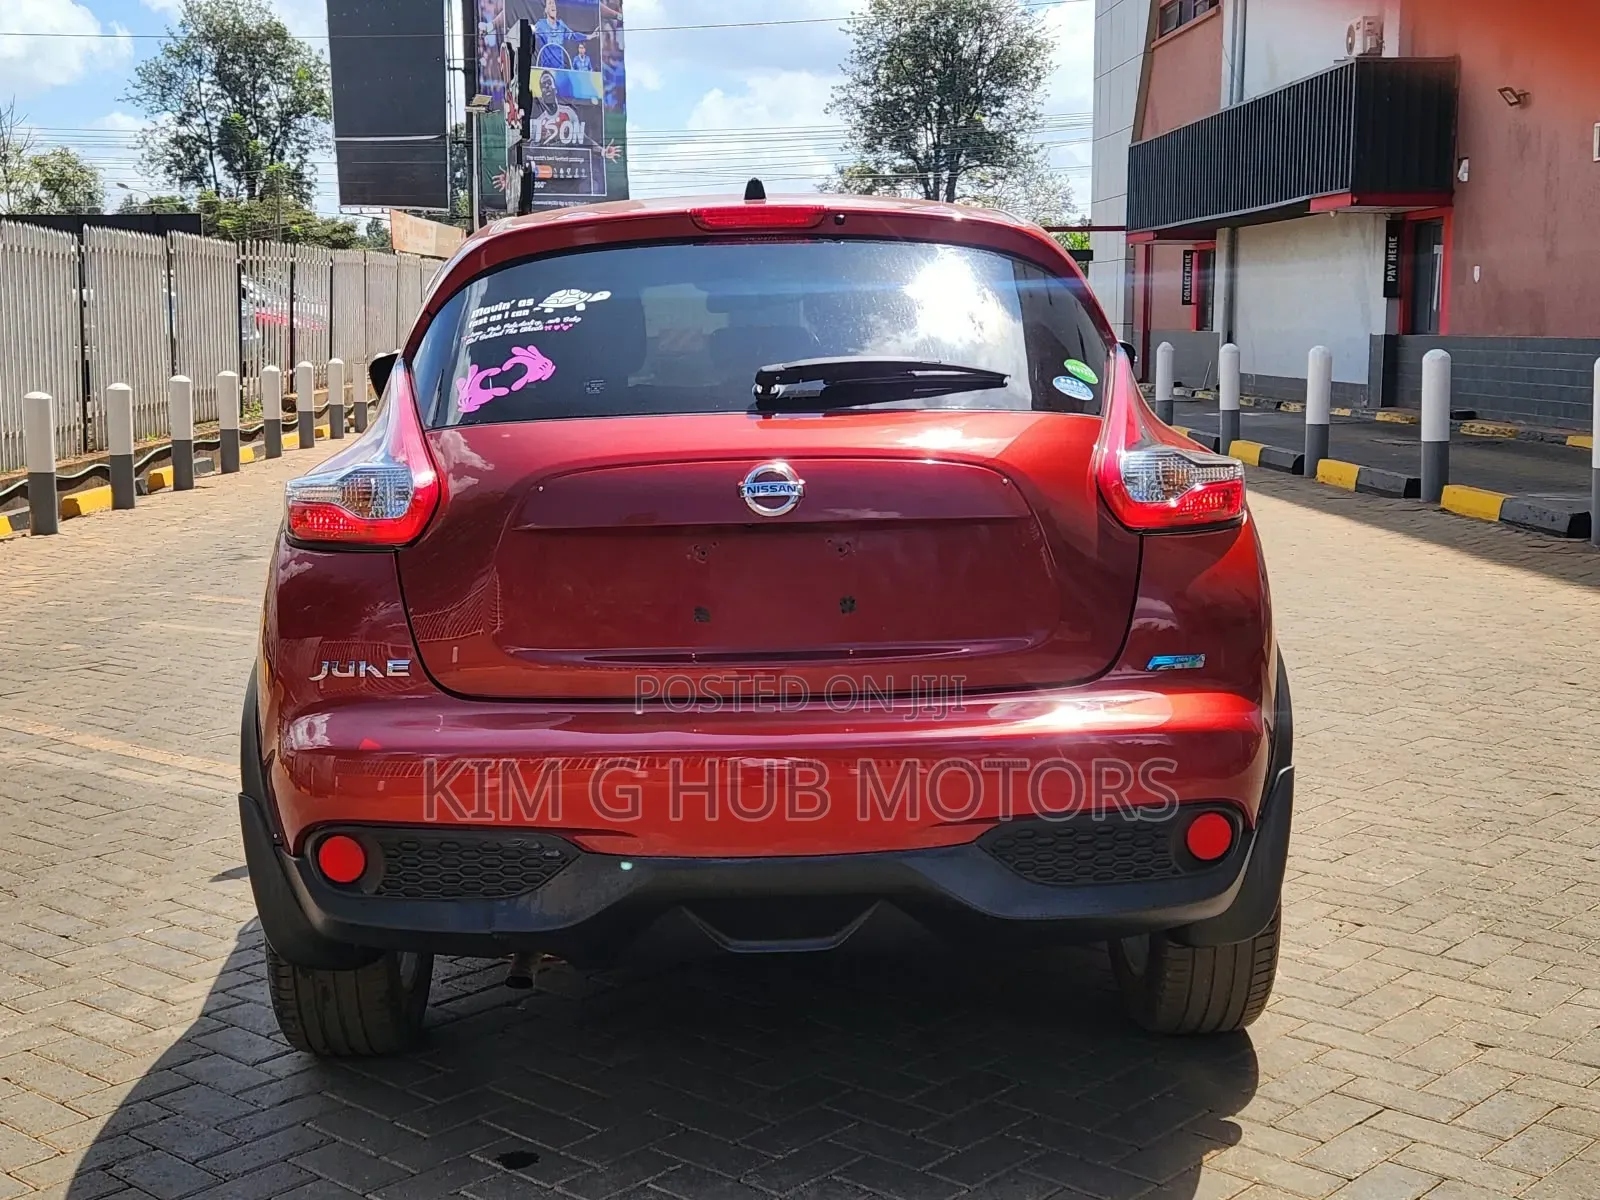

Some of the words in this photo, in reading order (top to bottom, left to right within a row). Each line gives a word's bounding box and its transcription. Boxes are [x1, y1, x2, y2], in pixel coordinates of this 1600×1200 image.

[560, 120, 586, 145] ON
[1387, 236, 1398, 261] HERE
[1184, 254, 1192, 272] HERE
[1386, 263, 1397, 282] PAY
[1183, 272, 1191, 301] COLLECT
[471, 299, 516, 318] Movin'
[517, 298, 535, 308] as
[468, 315, 489, 329] fast
[489, 313, 503, 322] as
[503, 310, 510, 320] I
[510, 309, 530, 318] can
[746, 484, 797, 495] NISSAN
[308, 659, 411, 682] JUKE
